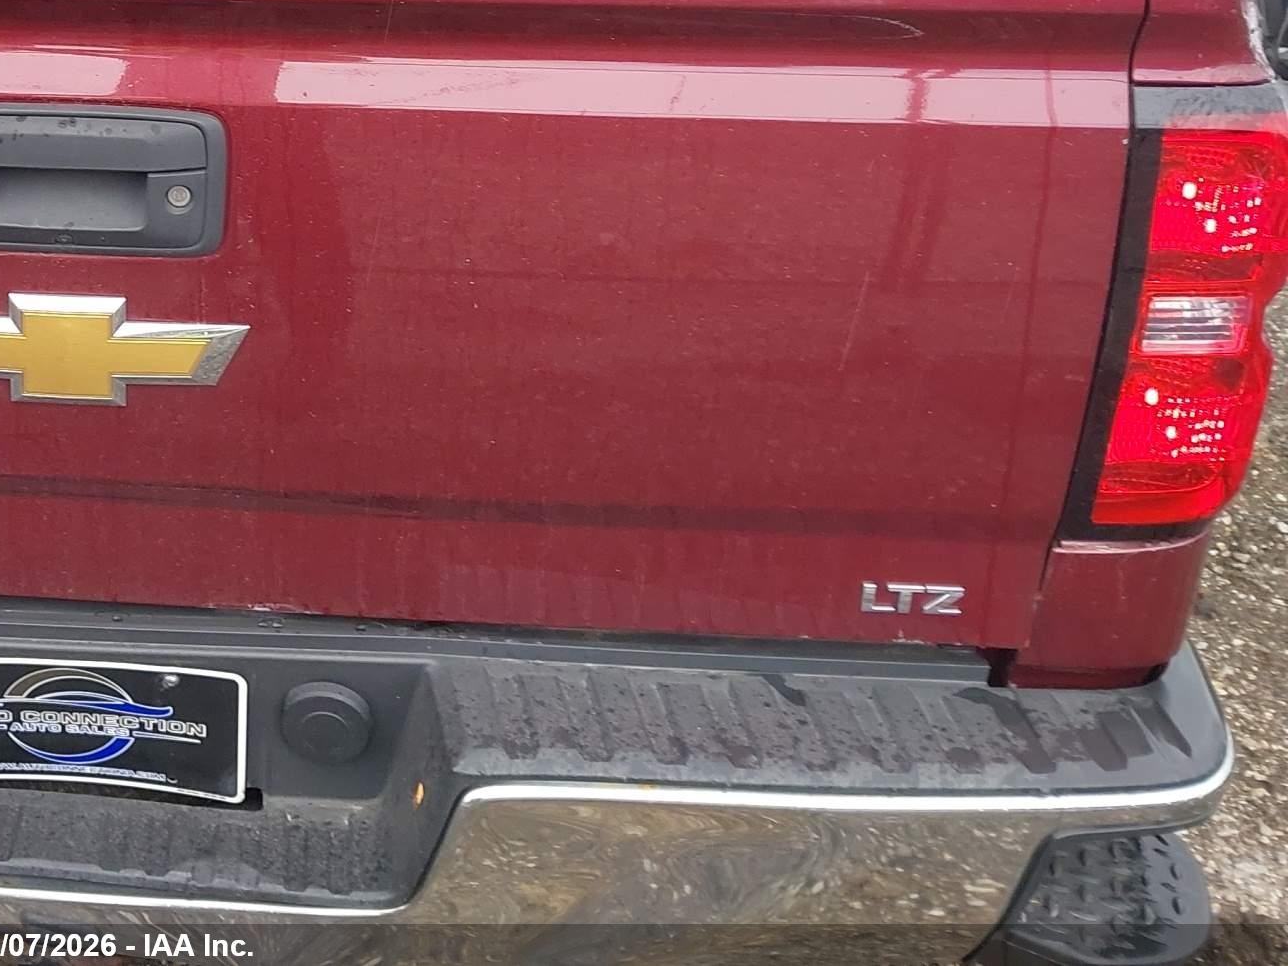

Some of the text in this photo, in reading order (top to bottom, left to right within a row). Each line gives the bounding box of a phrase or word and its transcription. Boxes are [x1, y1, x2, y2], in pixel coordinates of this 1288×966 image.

[860, 580, 967, 615] LTZ
[9, 721, 130, 737] AUTO SALES
[20, 709, 208, 738] CONNECTION
